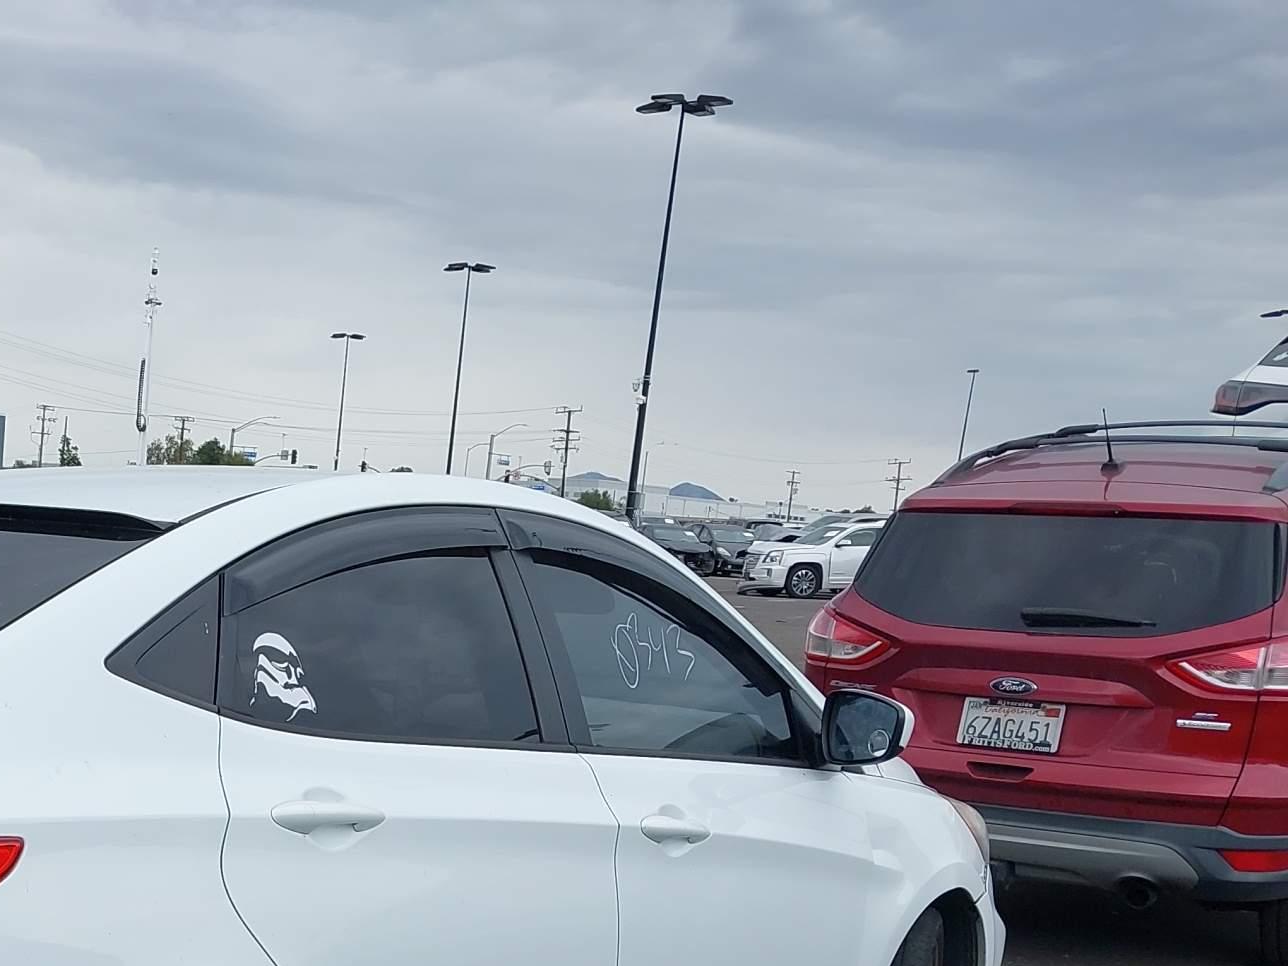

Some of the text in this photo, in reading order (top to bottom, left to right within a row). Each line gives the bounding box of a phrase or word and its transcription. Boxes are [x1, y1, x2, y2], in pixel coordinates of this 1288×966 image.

[610, 612, 696, 689] 0343
[984, 705, 1040, 717] California
[965, 716, 1051, 744] 6ZAG451
